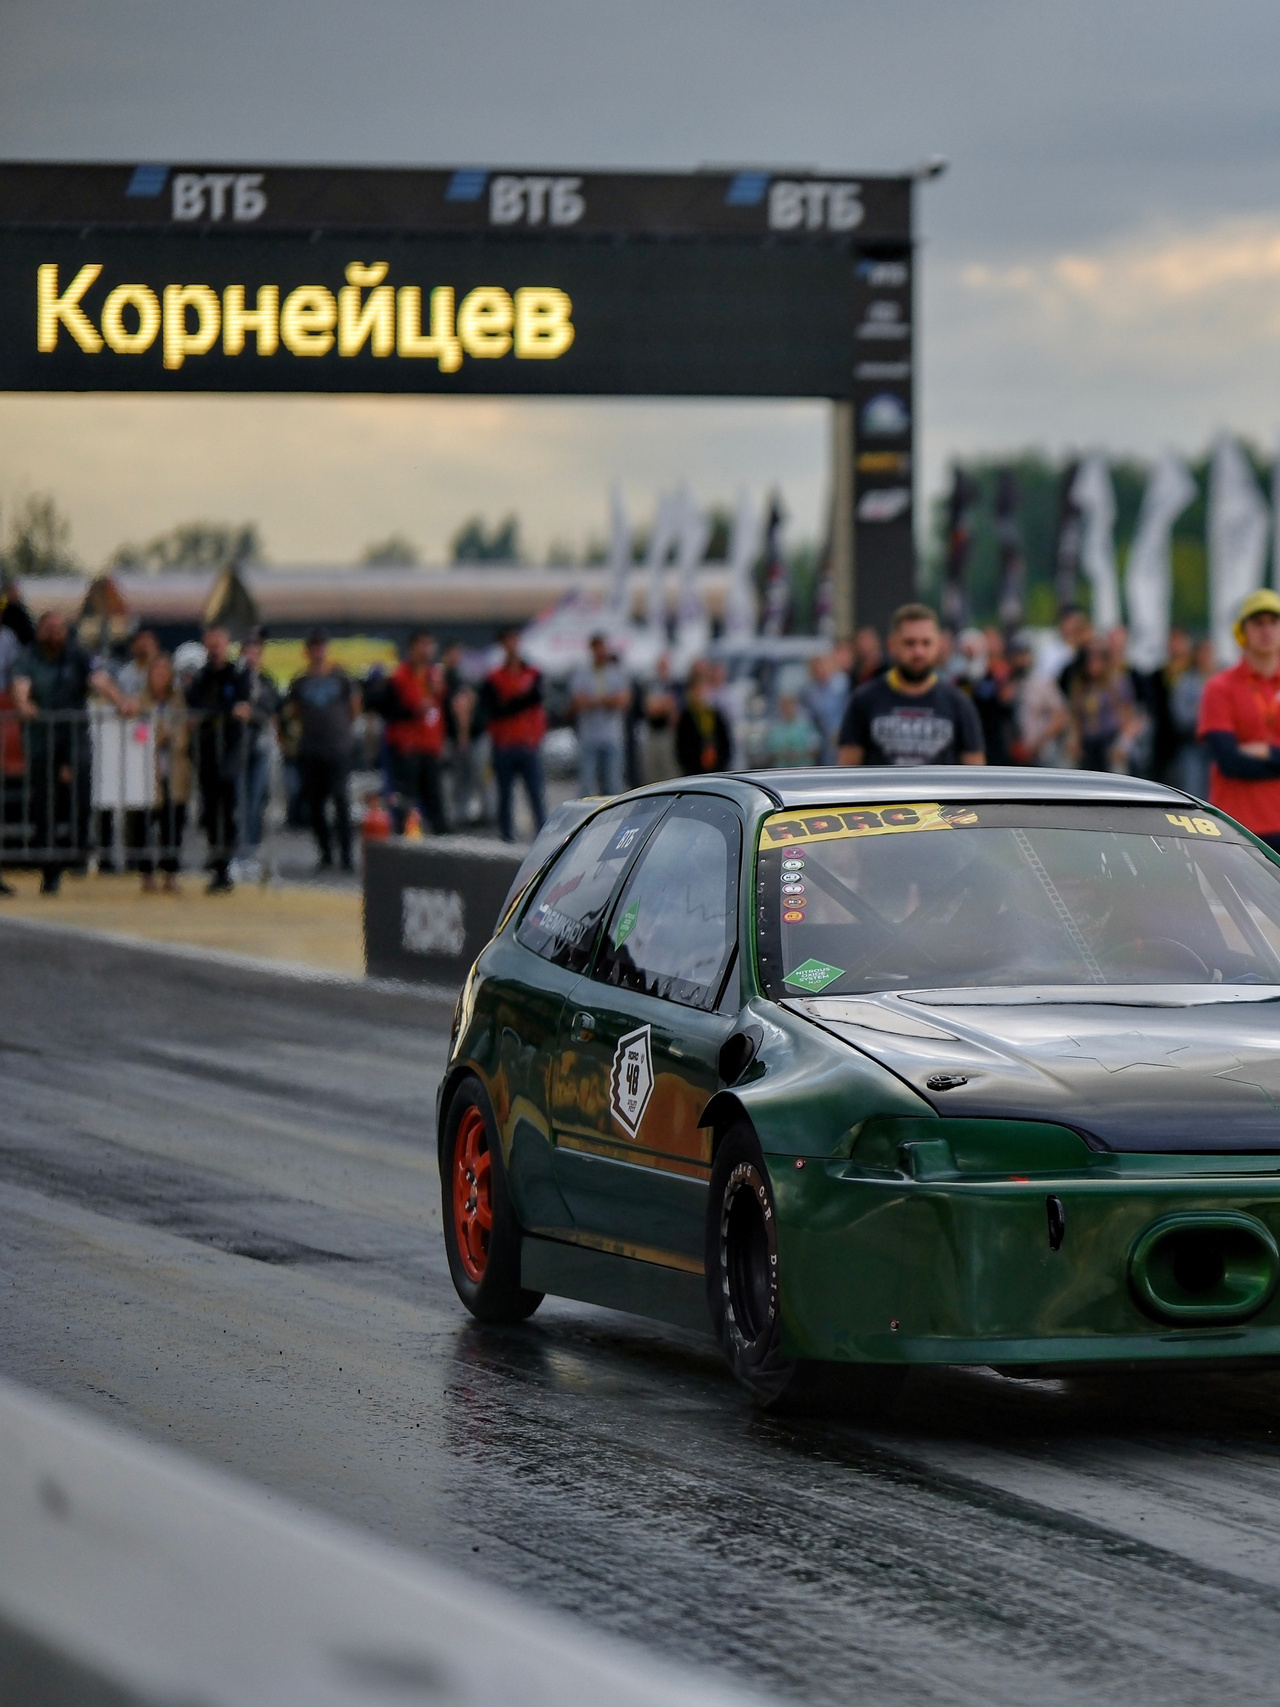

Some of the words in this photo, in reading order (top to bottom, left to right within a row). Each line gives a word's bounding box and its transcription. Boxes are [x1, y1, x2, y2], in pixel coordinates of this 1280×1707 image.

[171, 173, 267, 222] ВТБ
[488, 175, 586, 226] ВТБ
[766, 181, 865, 231] ВТБ
[37, 261, 575, 373] Корнейцев
[615, 828, 640, 850] ВТБ
[764, 807, 921, 842] RDRC
[1165, 814, 1221, 836] 48
[539, 907, 589, 944] DEMIKHOV
[795, 967, 831, 976] NITROUS
[799, 974, 830, 982] SYSTEM
[626, 1063, 640, 1096] 48
